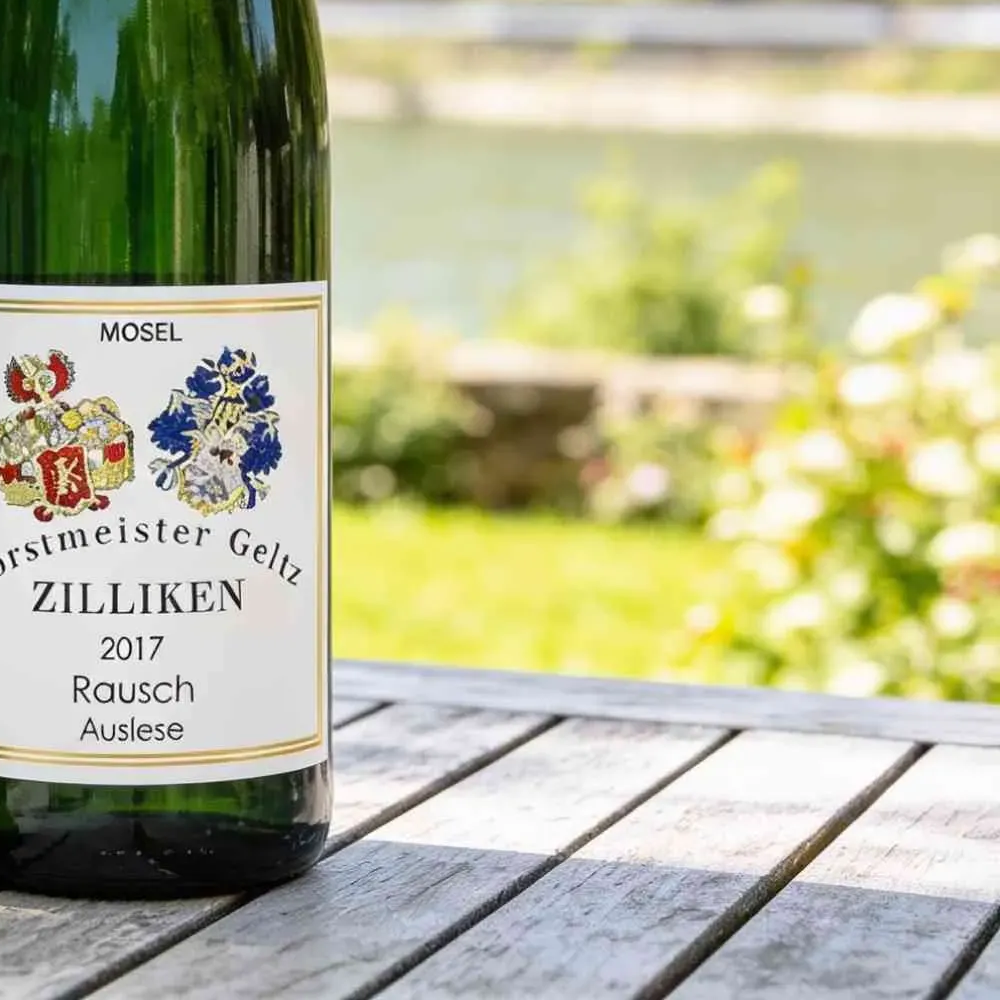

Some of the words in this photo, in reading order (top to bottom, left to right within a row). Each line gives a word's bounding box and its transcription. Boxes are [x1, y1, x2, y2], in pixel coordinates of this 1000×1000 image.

[100, 321, 183, 343] MOSEL
[229, 528, 303, 587] Geltz
[31, 578, 245, 615] ZILLIKEN
[100, 636, 165, 661] 2017
[73, 675, 195, 705] Rausch
[80, 717, 184, 742] Auslese
